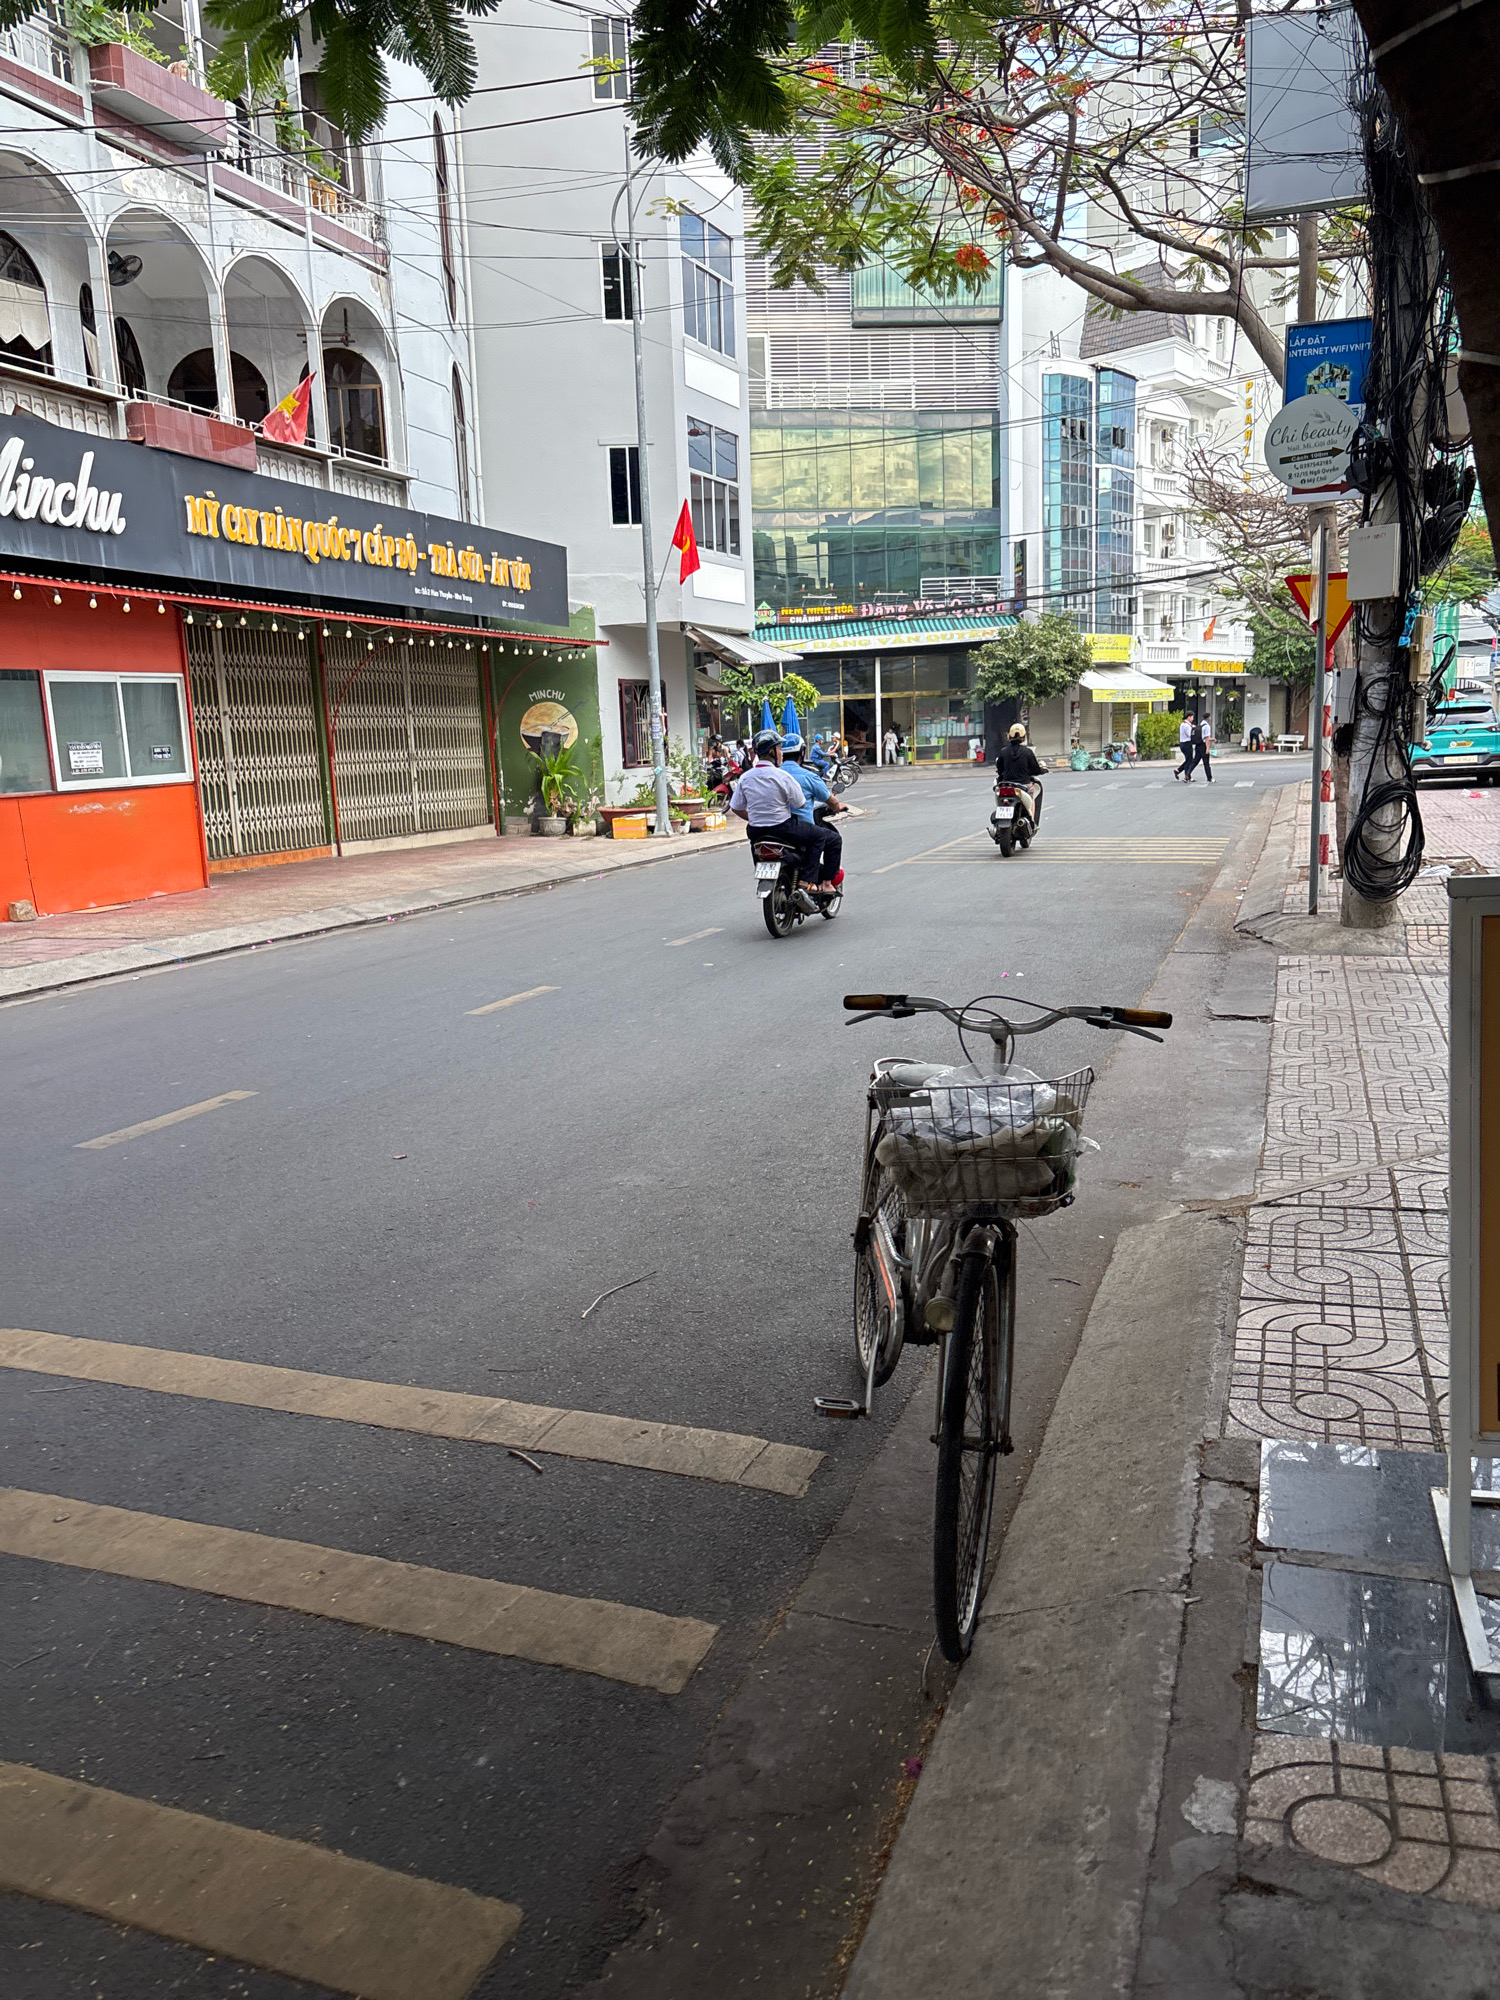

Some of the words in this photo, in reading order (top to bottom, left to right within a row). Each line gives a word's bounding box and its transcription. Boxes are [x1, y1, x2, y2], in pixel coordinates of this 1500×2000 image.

[1288, 346, 1329, 358] INTERNET
[1330, 344, 1348, 353] WIFI
[1270, 426, 1297, 447] Chi
[1301, 419, 1353, 442] beauty
[1310, 451, 1329, 460] 100m
[221, 504, 259, 546] CAY
[259, 506, 303, 553] HÀN
[303, 515, 351, 564] QUỐC
[349, 528, 362, 563] 7
[362, 523, 396, 567] CẤP
[394, 532, 418, 576] ĐỘ
[428, 541, 459, 579] TRÀ
[806, 606, 832, 615] NINH
[528, 689, 566, 702] MINCHU
